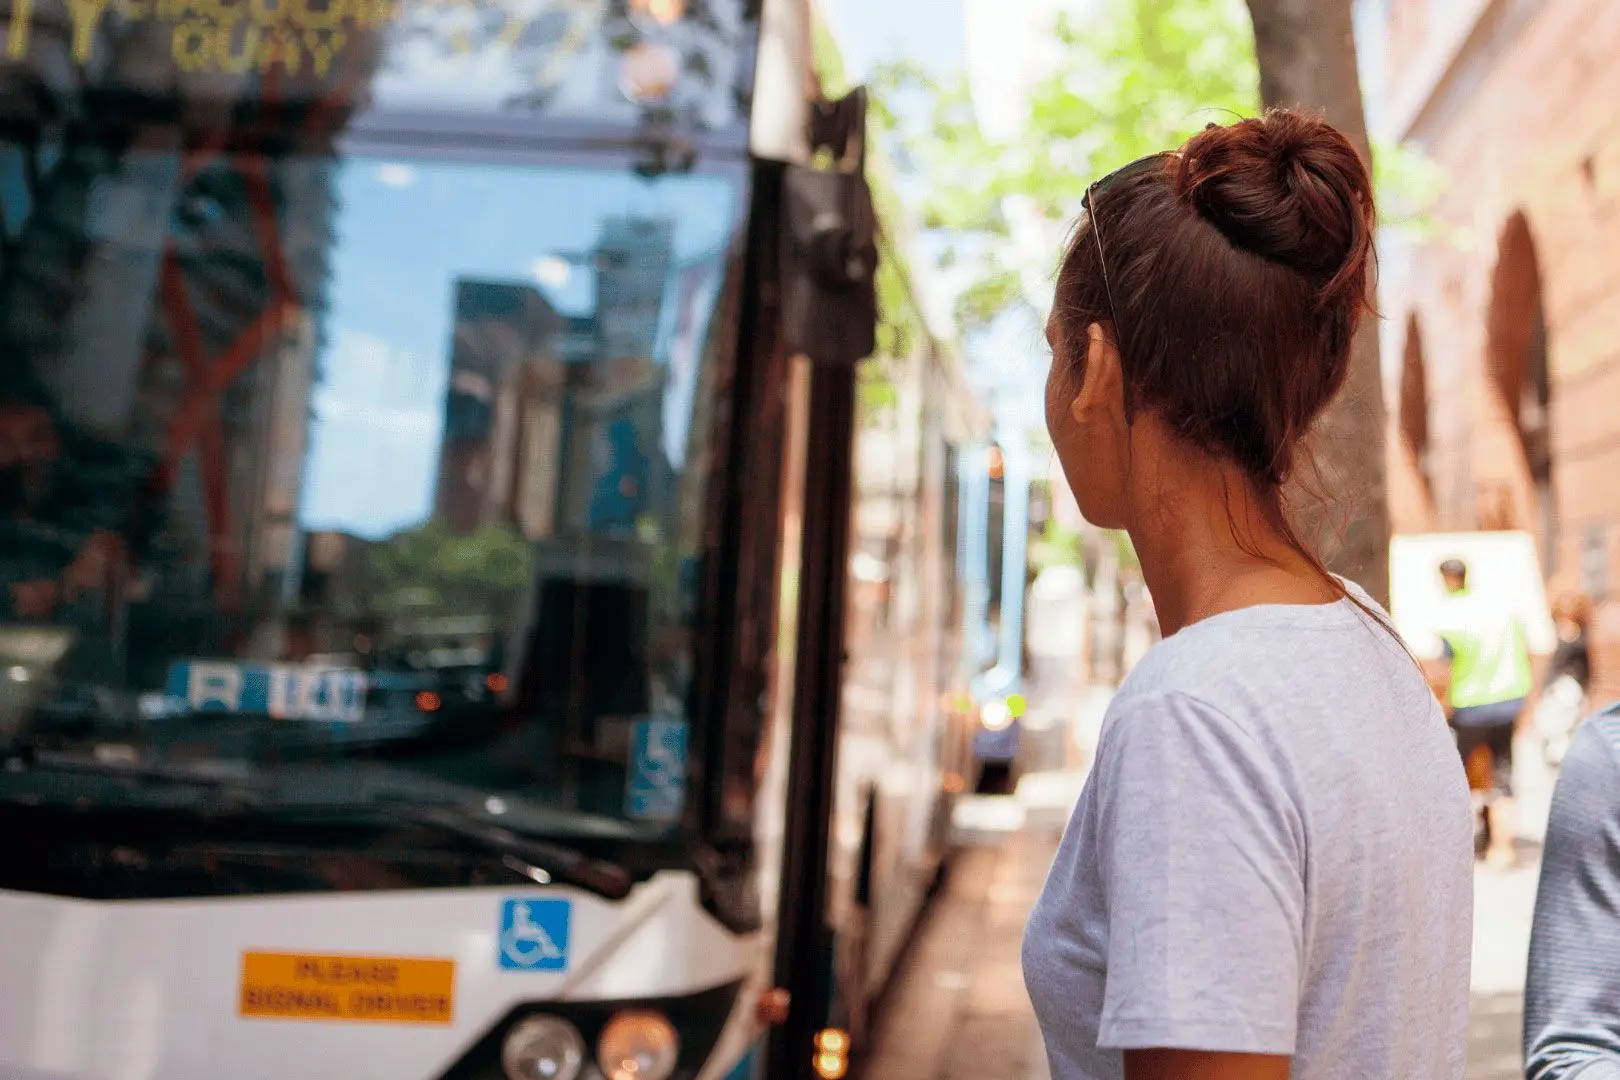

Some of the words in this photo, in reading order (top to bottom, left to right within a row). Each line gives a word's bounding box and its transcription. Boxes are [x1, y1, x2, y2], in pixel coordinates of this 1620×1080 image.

[295, 958, 398, 986] PLEASE
[246, 985, 338, 1013] SIGNAL
[350, 990, 449, 1017] DRIVER
